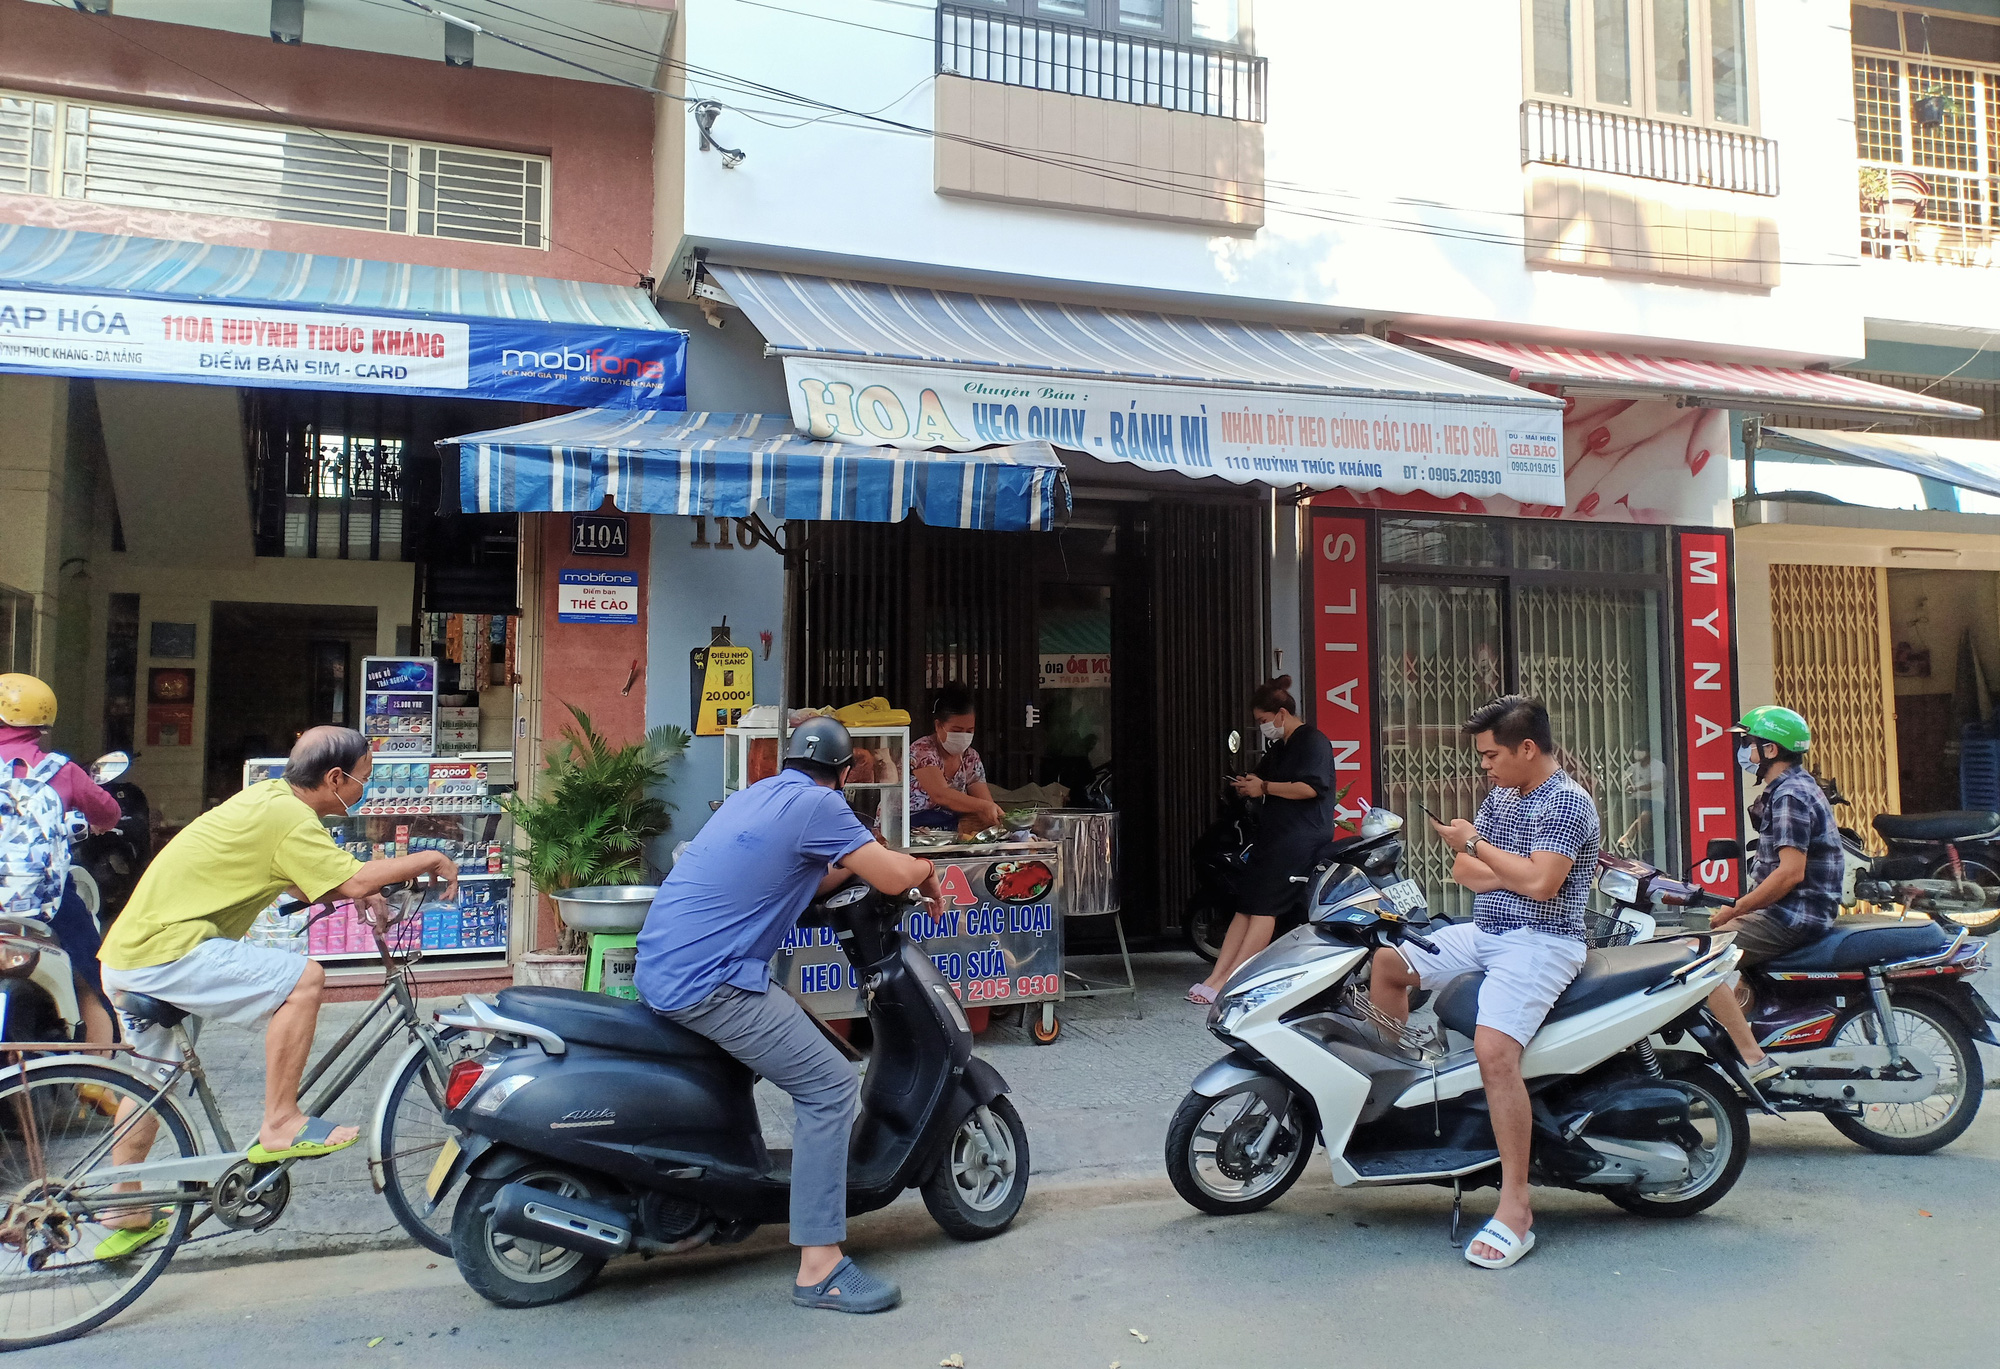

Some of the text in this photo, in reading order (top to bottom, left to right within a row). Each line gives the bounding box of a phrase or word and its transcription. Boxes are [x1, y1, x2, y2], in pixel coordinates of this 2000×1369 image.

[58, 305, 131, 336] HÓA
[161, 314, 445, 359] 110A HUỲNH THÚC KHÁNG
[22, 344, 50, 360] THÚC
[53, 345, 89, 361] KHÁNG
[199, 349, 251, 371] ĐIỂM
[258, 354, 298, 374] BÁN
[304, 360, 340, 377] SIM
[355, 363, 408, 380] CARD
[502, 346, 664, 379] mobifone
[963, 381, 1030, 399] Chuyên
[1037, 386, 1075, 401] Bán
[799, 377, 971, 442] HOA
[972, 402, 1023, 442] HEO
[1028, 405, 1088, 450] QUAY
[1110, 400, 1178, 465] BÁNH
[1180, 404, 1213, 468] MÌ
[1221, 405, 1264, 452] NHẬN
[1266, 407, 1294, 453] ĐẶT
[1298, 415, 1327, 448] HEO
[1330, 411, 1370, 451] CÚNG
[1373, 414, 1400, 452] CÁC
[1403, 421, 1433, 461] LOẠI
[1444, 424, 1469, 457] HEO
[1473, 421, 1500, 458] SỮA
[1510, 441, 1557, 458] GIA BẢO
[1225, 455, 1383, 478] 110 HUỲNH THÚC KHÁNG
[1403, 465, 1417, 480] ĐT
[1428, 466, 1502, 485] 0905.205930
[1511, 461, 1557, 474] 0905.019.015
[576, 523, 625, 549] 110A
[565, 573, 632, 583] mobifone
[570, 597, 629, 610] THẺ CÀO
[442, 720, 478, 728] Heineken
[965, 901, 1005, 937] CÁC
[1009, 902, 1052, 938] LOẠI
[800, 962, 843, 994] HEO
[966, 940, 1006, 979] SỮA
[967, 978, 1011, 1001] 205
[1017, 974, 1059, 997] 930
